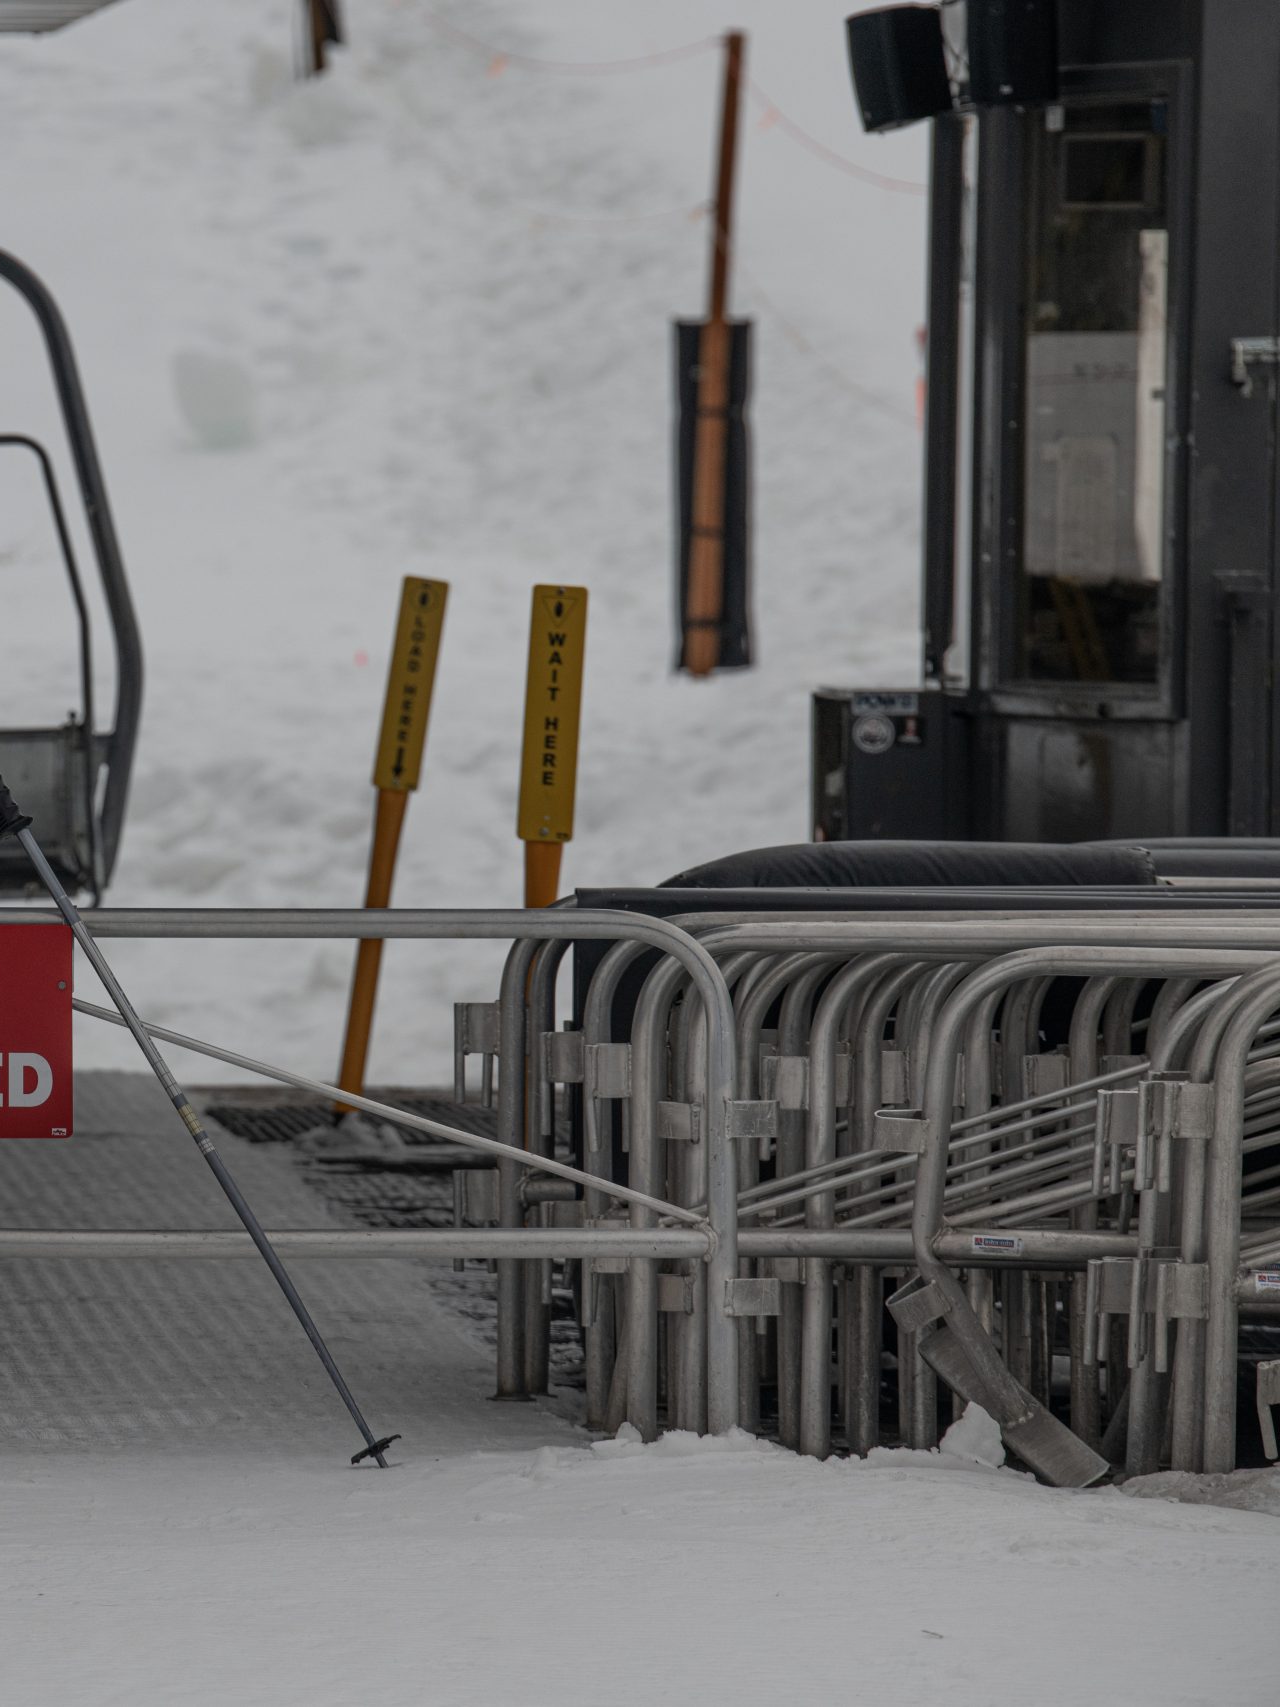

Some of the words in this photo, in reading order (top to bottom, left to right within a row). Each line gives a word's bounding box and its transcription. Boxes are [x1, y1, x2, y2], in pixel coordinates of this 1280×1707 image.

[407, 616, 426, 673] LOAD
[547, 632, 567, 703] WAIT
[397, 684, 417, 743] HERE
[541, 716, 559, 787] HERE
